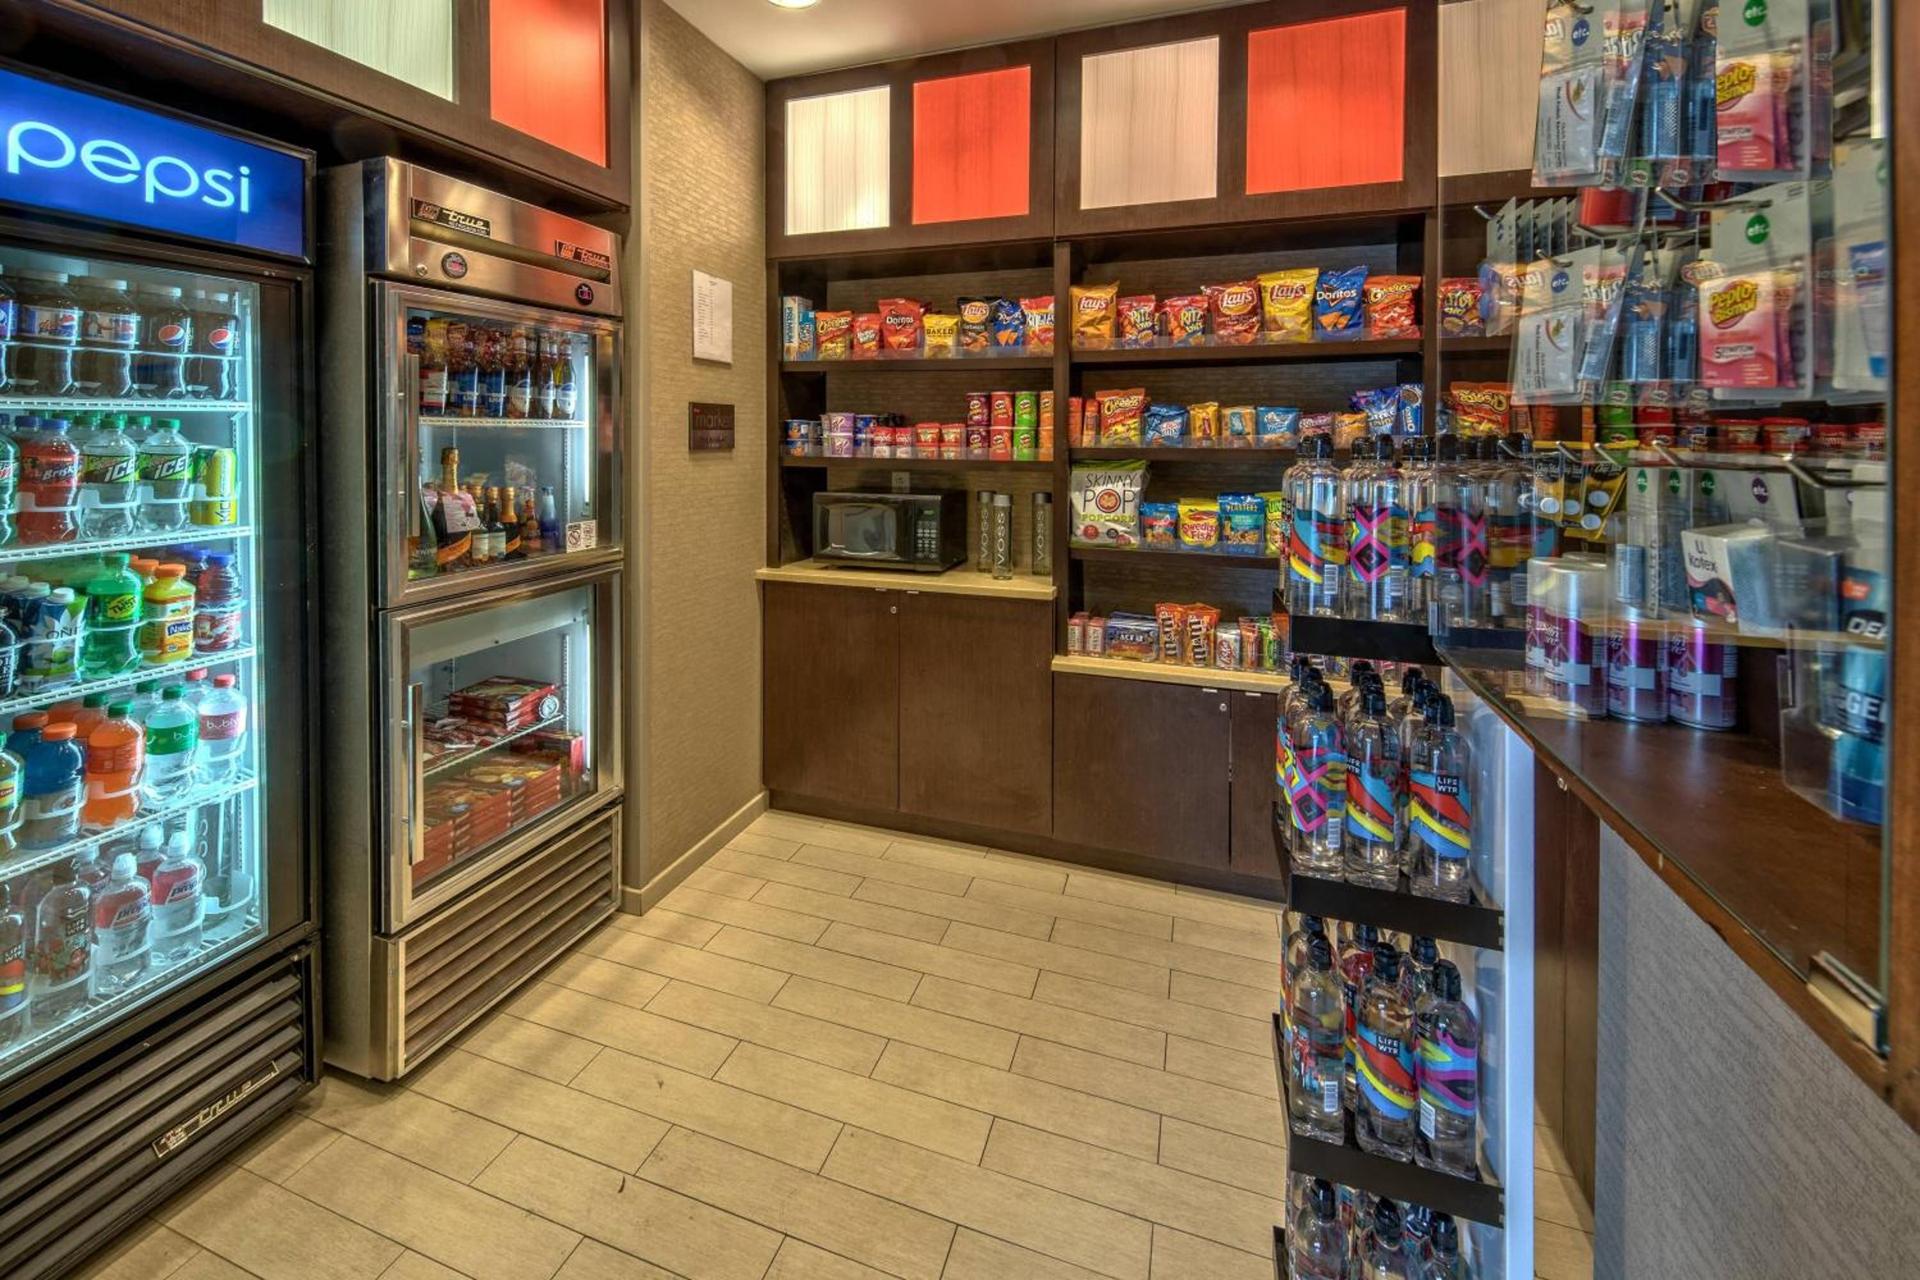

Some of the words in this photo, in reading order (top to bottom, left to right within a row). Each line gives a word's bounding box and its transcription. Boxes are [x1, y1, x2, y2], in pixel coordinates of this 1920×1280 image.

[7, 121, 250, 213] pepsi
[1222, 292, 1253, 308] Lay's
[1272, 284, 1304, 300] Lay's
[1317, 288, 1357, 301] Doritos
[1080, 297, 1107, 311] Lay's
[104, 459, 136, 482] ICE
[154, 455, 187, 481] ICE
[1086, 472, 1137, 488] SKINNY
[1083, 488, 1136, 514] POP
[1081, 513, 1136, 524] POPCORN
[996, 512, 1006, 565] VOSS
[1036, 510, 1045, 561] VOSS
[1437, 776, 1457, 786] LIFE
[1437, 784, 1458, 793] WTR
[1377, 1044, 1398, 1055] WTR
[1378, 1036, 1399, 1047] LIFE
